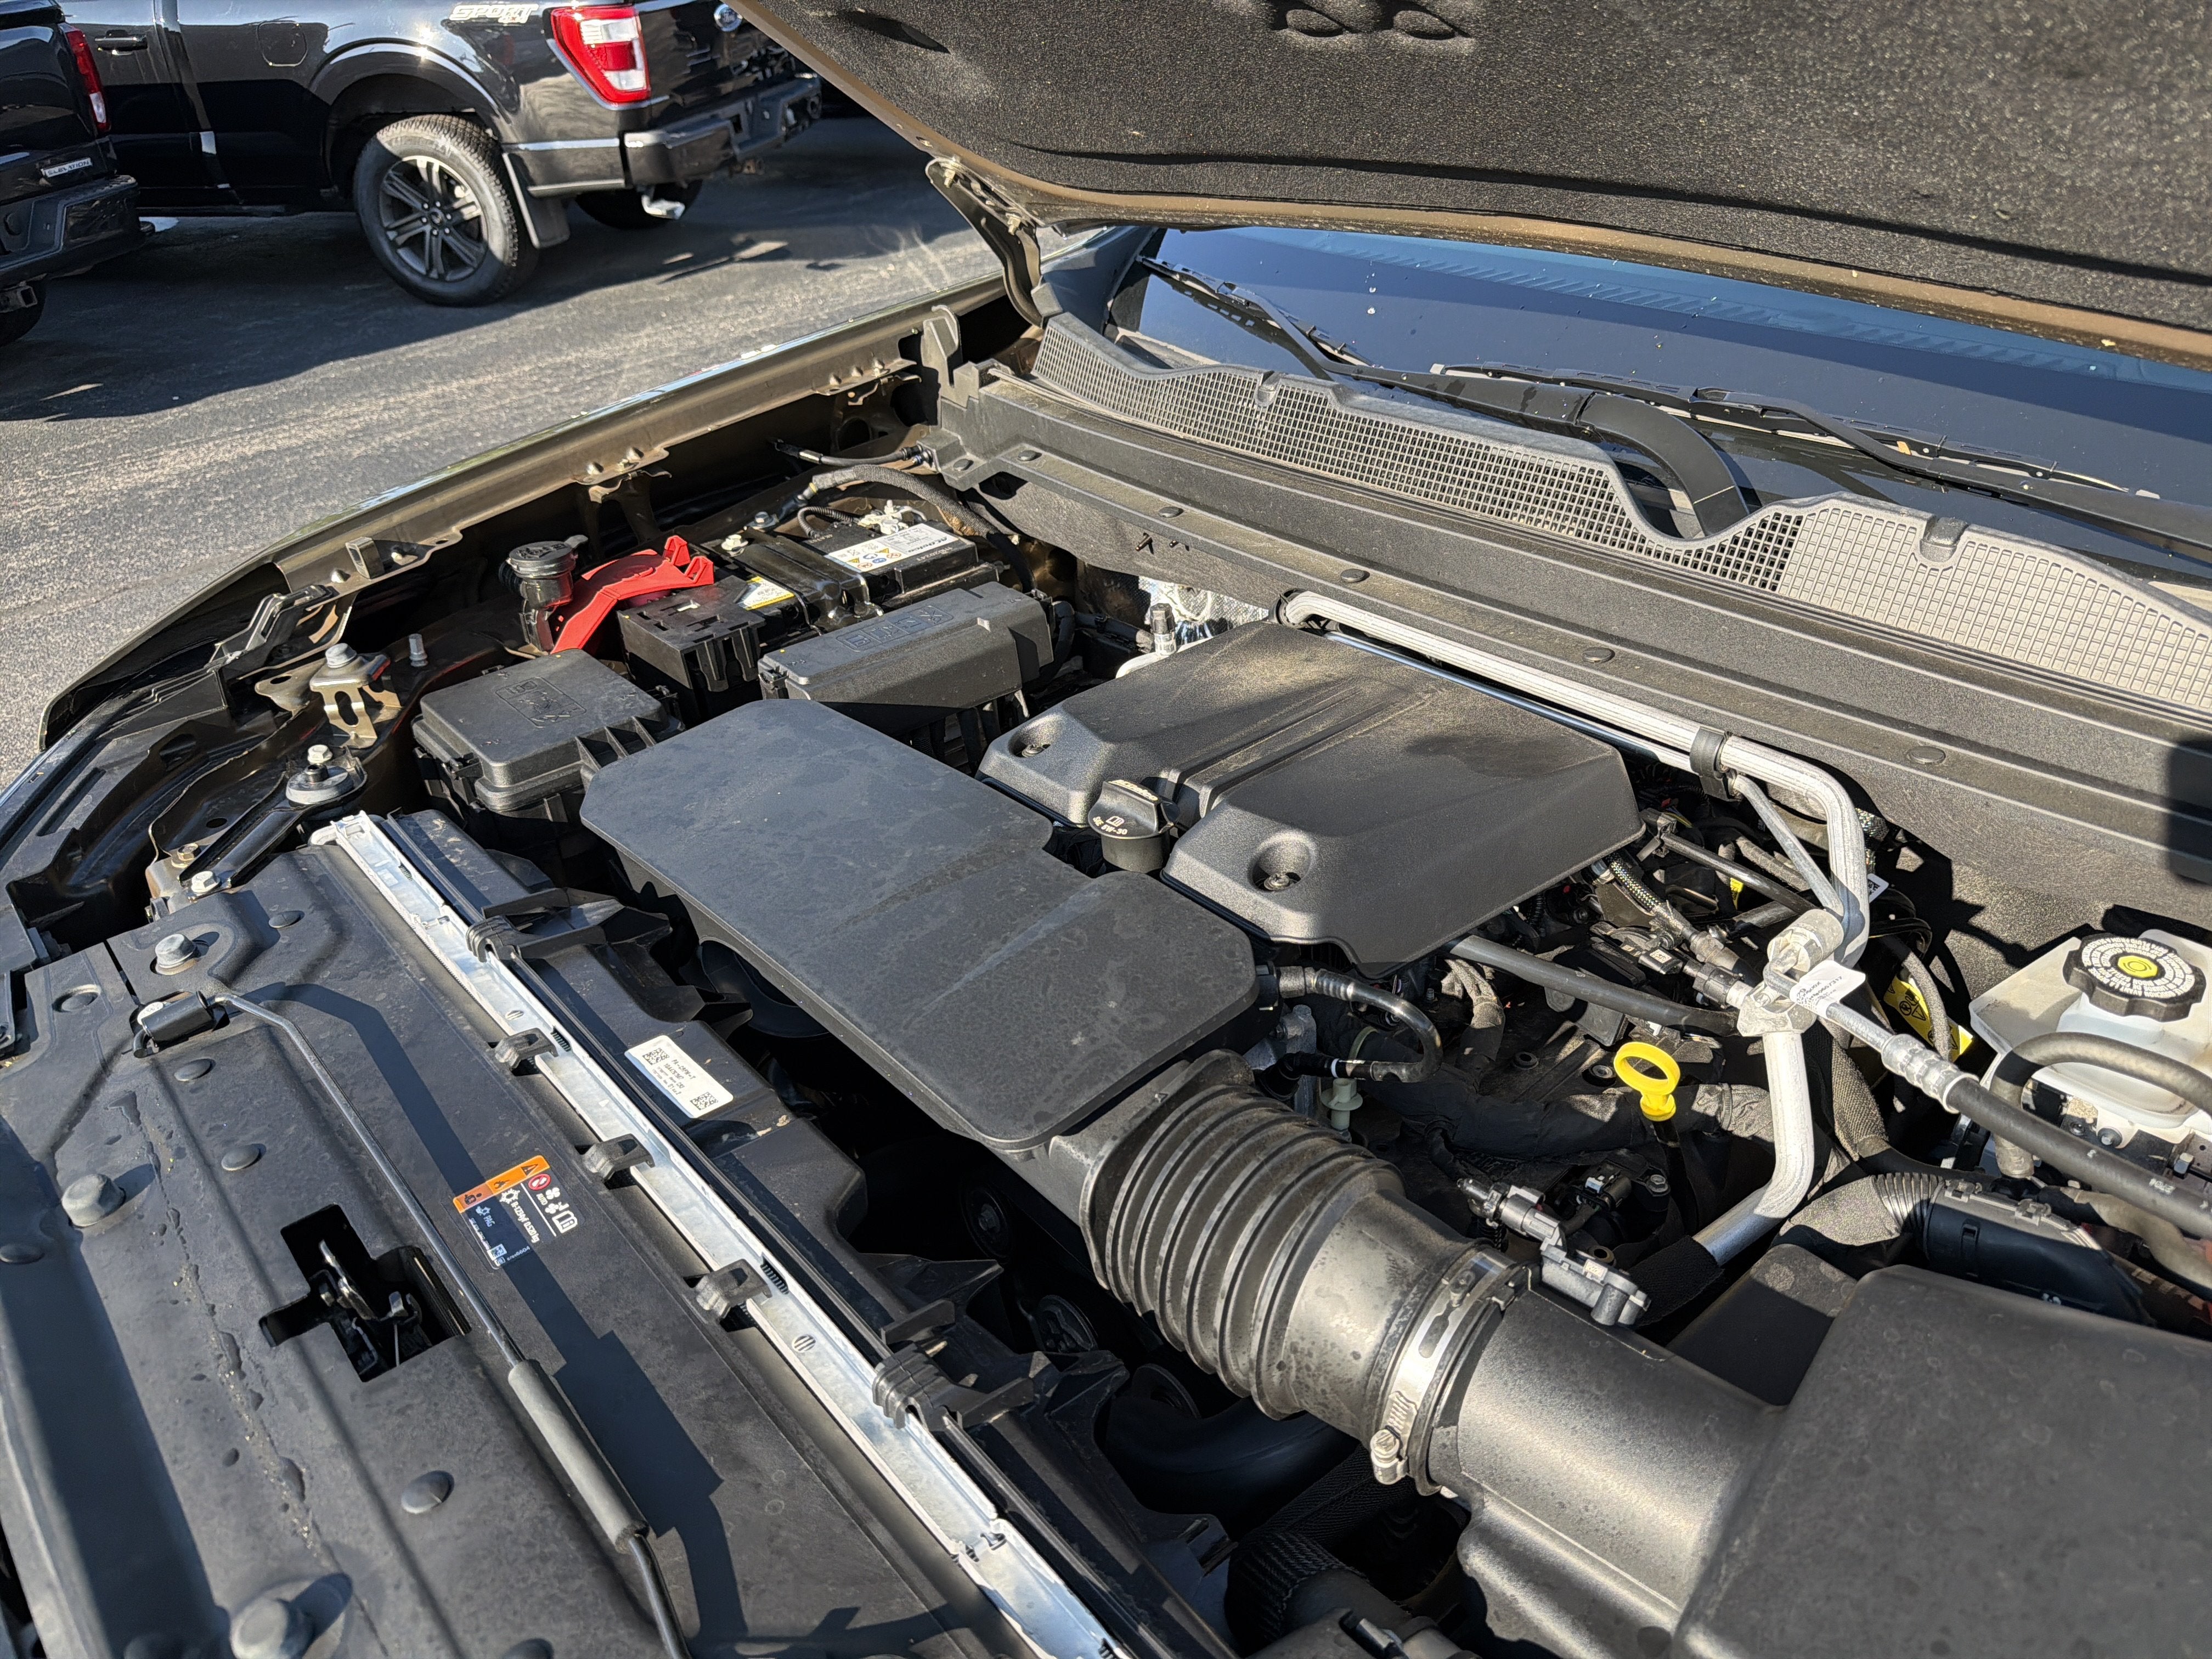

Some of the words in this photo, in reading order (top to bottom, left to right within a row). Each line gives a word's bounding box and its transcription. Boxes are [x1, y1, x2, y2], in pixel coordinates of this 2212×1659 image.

[449, 4, 539, 20] SPORT
[48, 161, 89, 175] ELEVATION
[2110, 976, 2130, 987] FREIN
[2119, 986, 2142, 996] AVANT
[536, 1193, 548, 1206] AUTO
[484, 1215, 495, 1227] PAG
[524, 1221, 537, 1237] 0.520
[531, 1233, 540, 1243] kg
